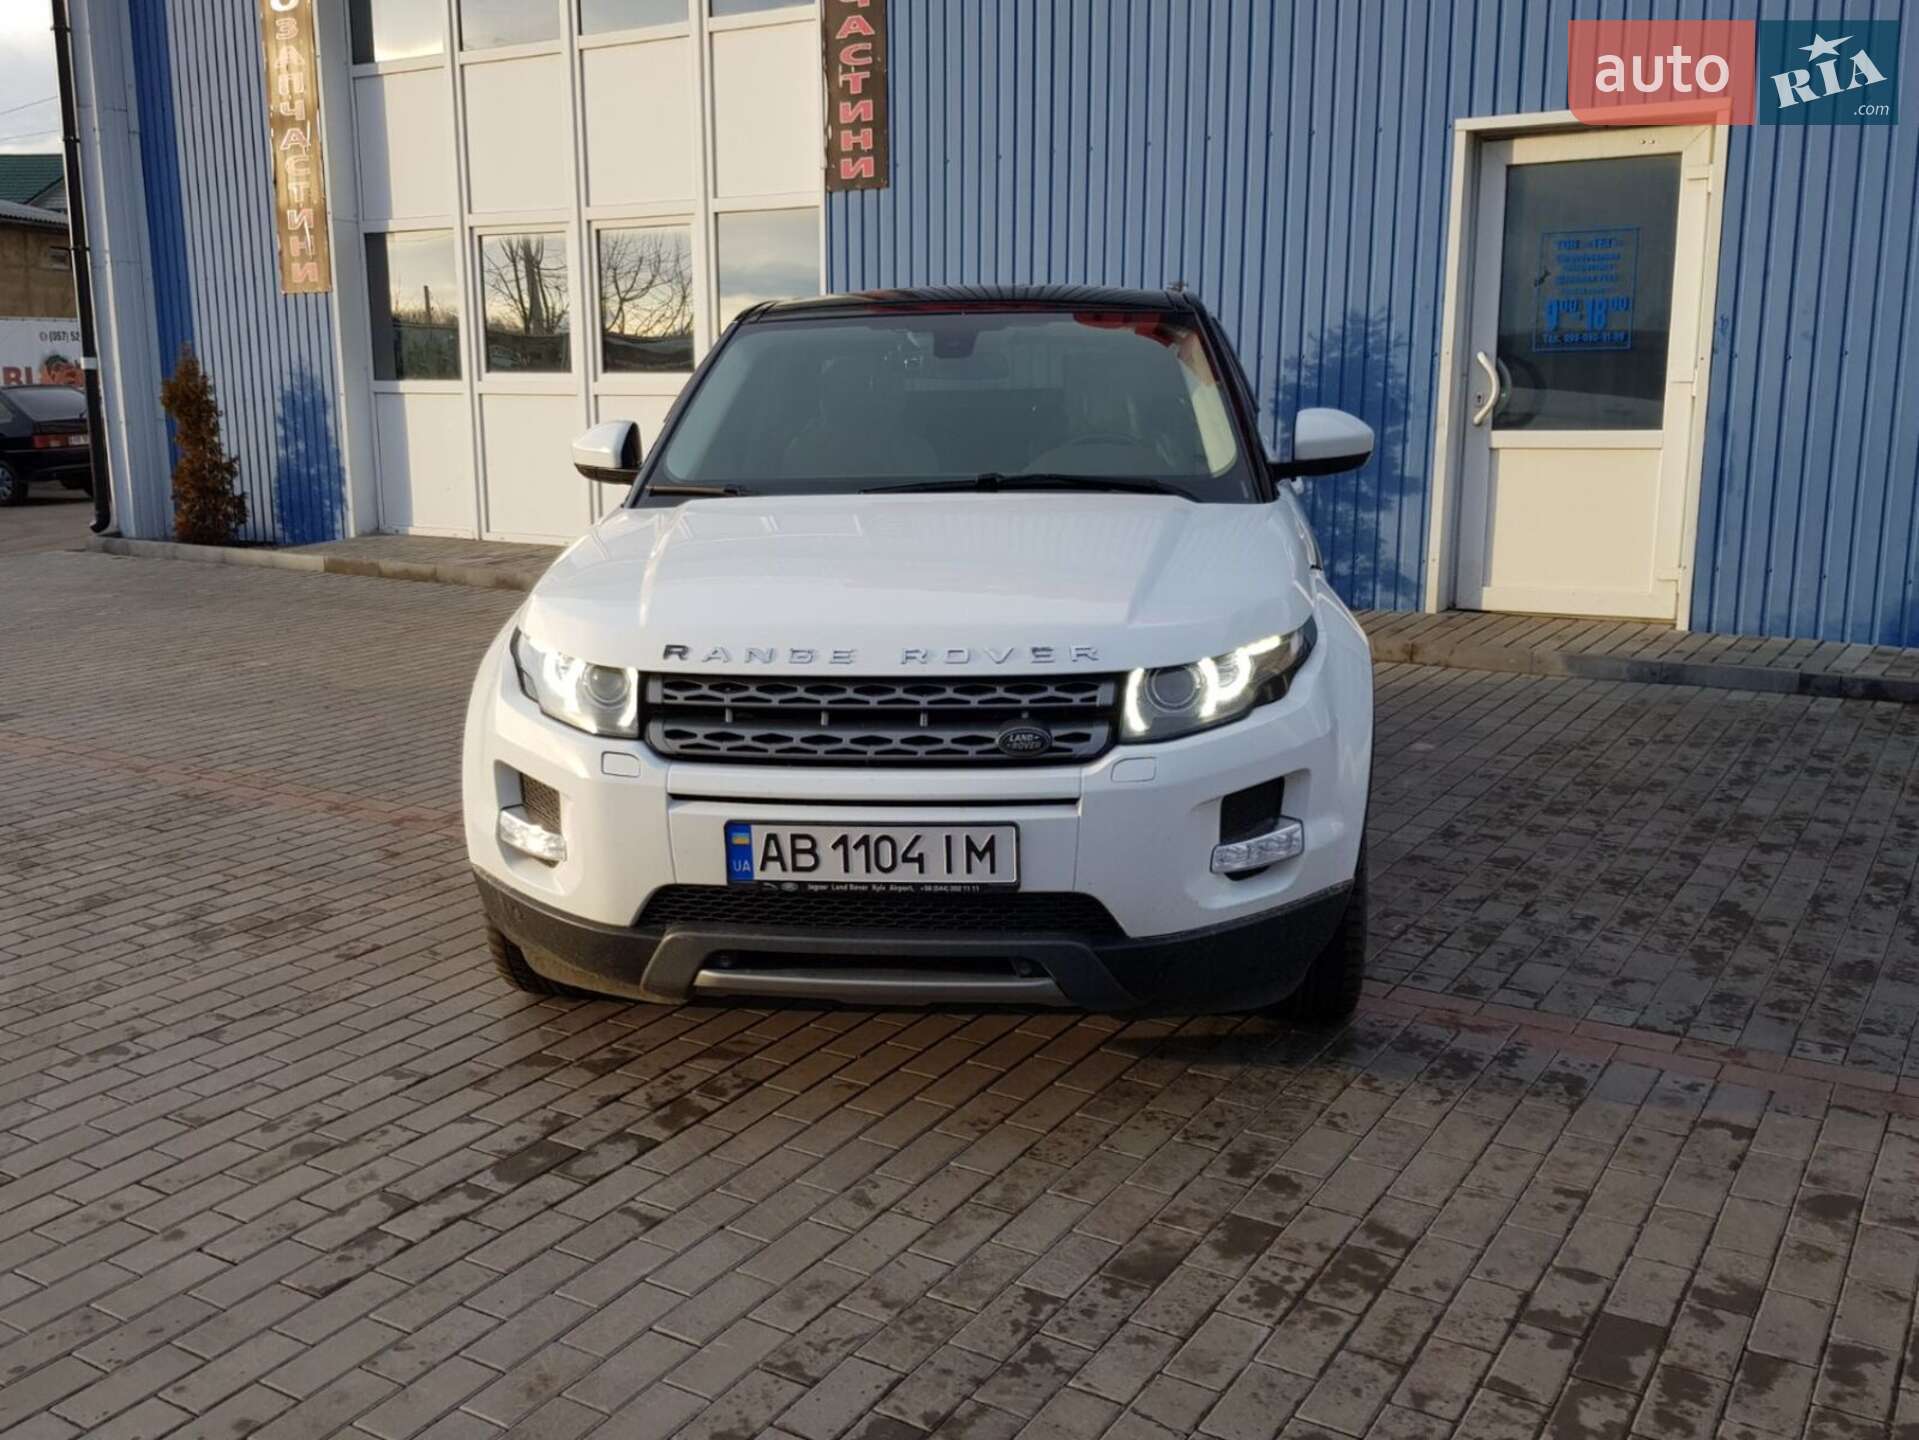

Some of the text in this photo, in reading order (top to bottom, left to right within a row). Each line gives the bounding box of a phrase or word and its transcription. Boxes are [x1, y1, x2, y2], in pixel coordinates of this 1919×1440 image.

[662, 644, 1100, 665] RANGE ROVER
[759, 832, 997, 875] AB 1104 IM
[732, 859, 751, 873] UA
